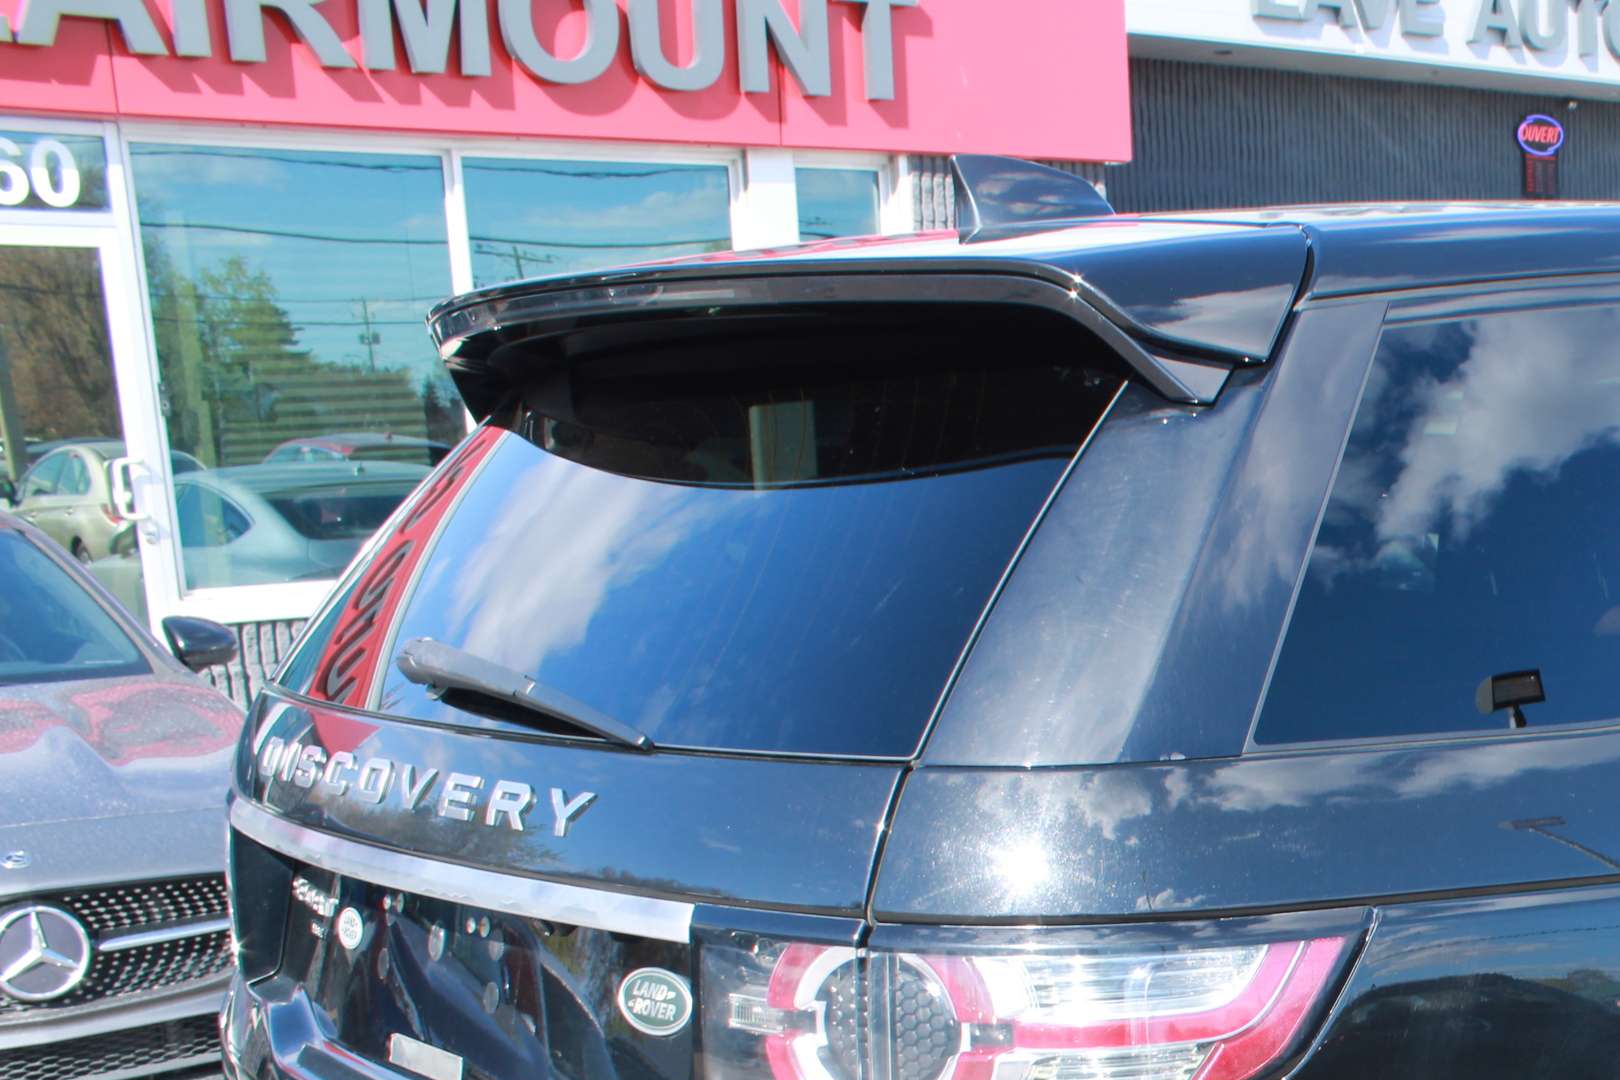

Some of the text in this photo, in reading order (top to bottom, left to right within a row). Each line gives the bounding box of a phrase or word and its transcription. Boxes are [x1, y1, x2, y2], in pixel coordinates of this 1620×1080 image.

[0, 0, 919, 101] MOUNT
[1521, 124, 1560, 144] OUVERT
[261, 735, 599, 838] DISCOVERY
[632, 979, 669, 1001] LAND
[632, 997, 677, 1021] ROVER
